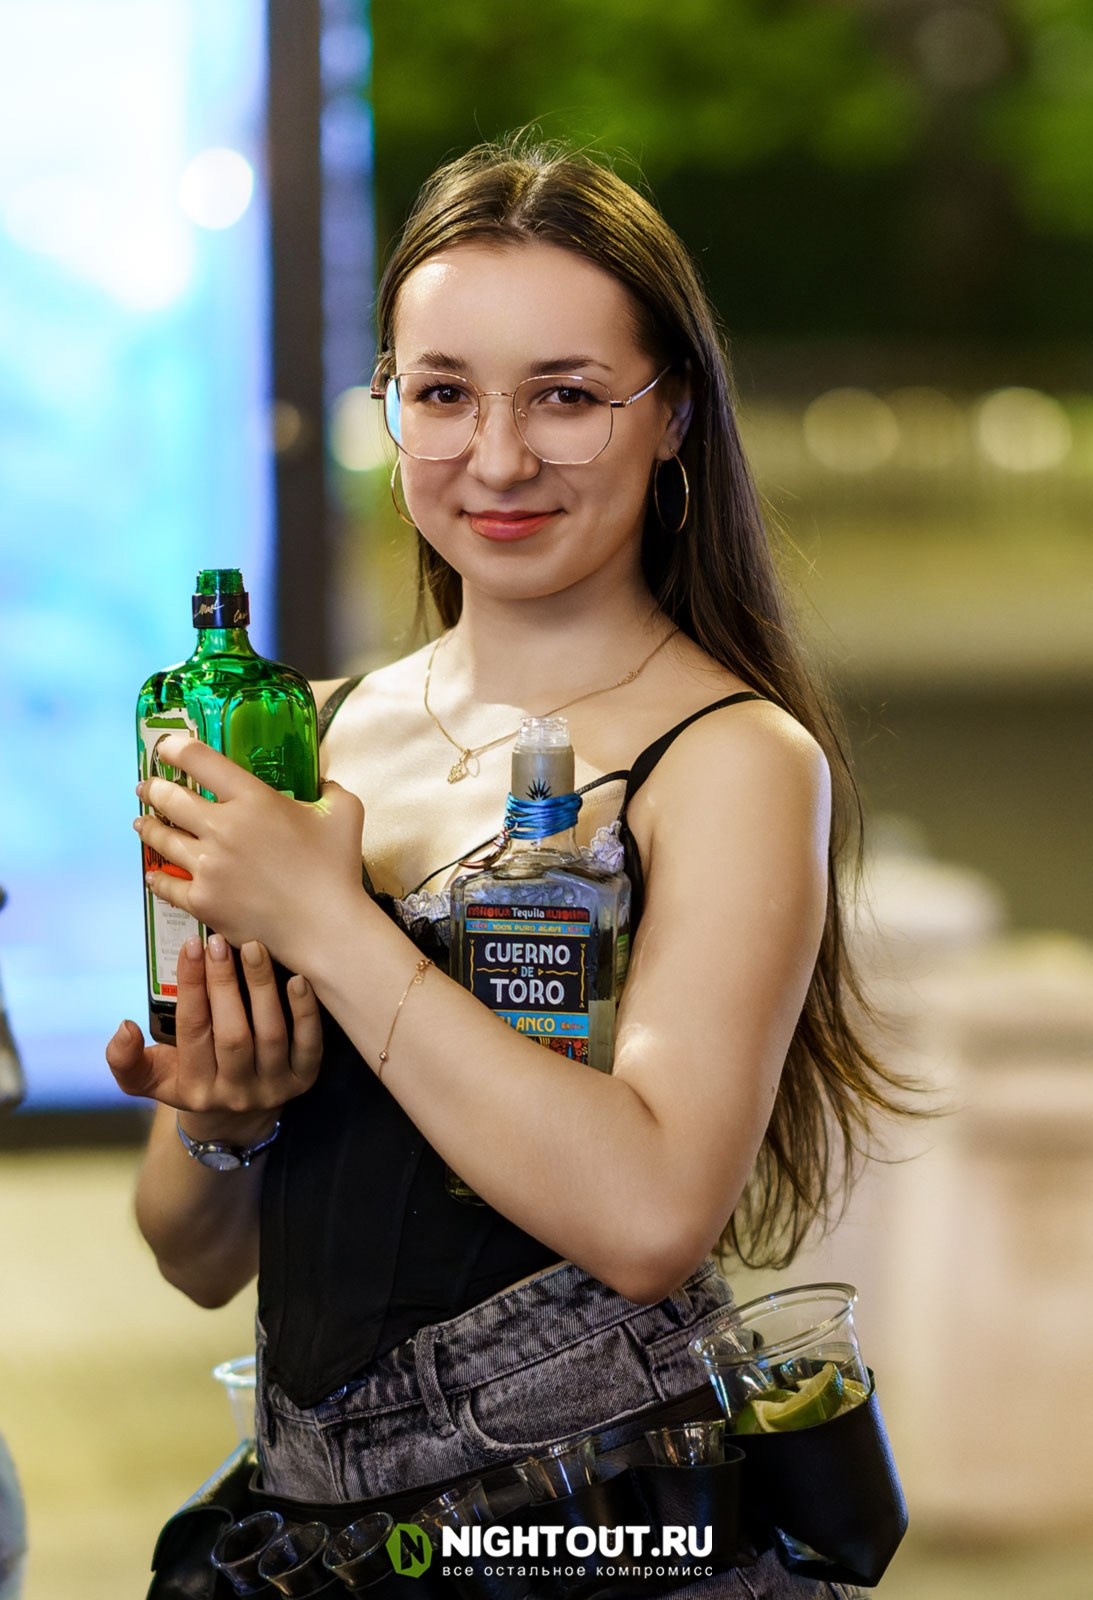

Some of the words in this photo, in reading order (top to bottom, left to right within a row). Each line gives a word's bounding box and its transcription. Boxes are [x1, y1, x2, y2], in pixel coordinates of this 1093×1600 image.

[511, 907, 545, 919] Tequila
[514, 924, 535, 932] PURO
[484, 942, 571, 965] CUERNO
[521, 966, 535, 978] DE
[490, 978, 565, 1005] TORO
[499, 1015, 556, 1032] ANCO
